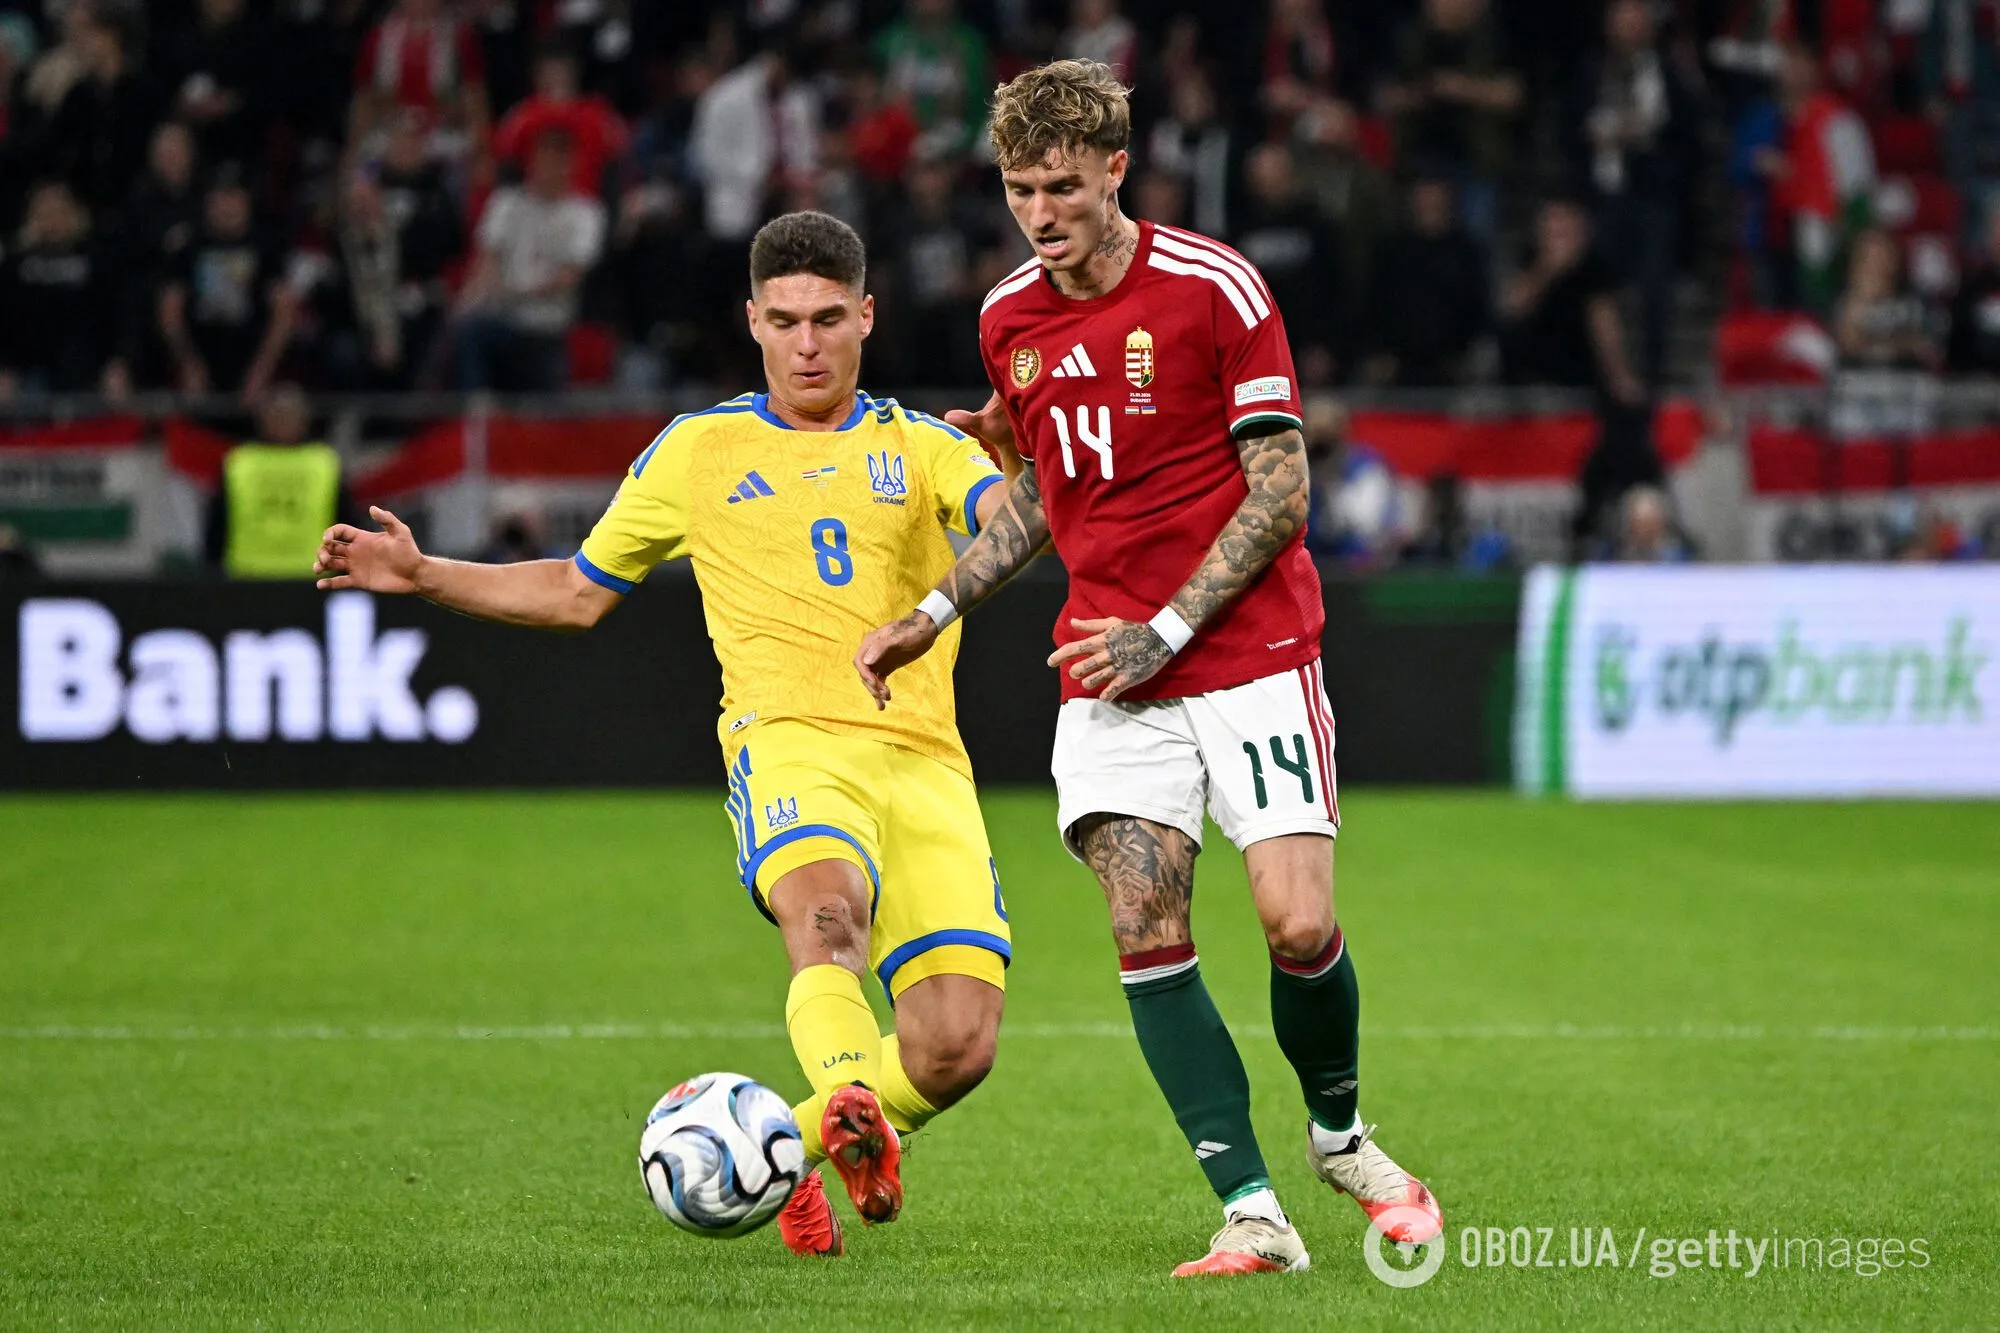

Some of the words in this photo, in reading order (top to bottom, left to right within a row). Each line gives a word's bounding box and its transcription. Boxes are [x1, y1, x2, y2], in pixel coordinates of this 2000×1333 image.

[1050, 405, 1114, 480] 14
[872, 496, 906, 506] UKRAINE
[810, 517, 854, 587] 8
[18, 591, 480, 744] Bank.
[1242, 733, 1315, 810] 14
[823, 1051, 867, 1069] UAF
